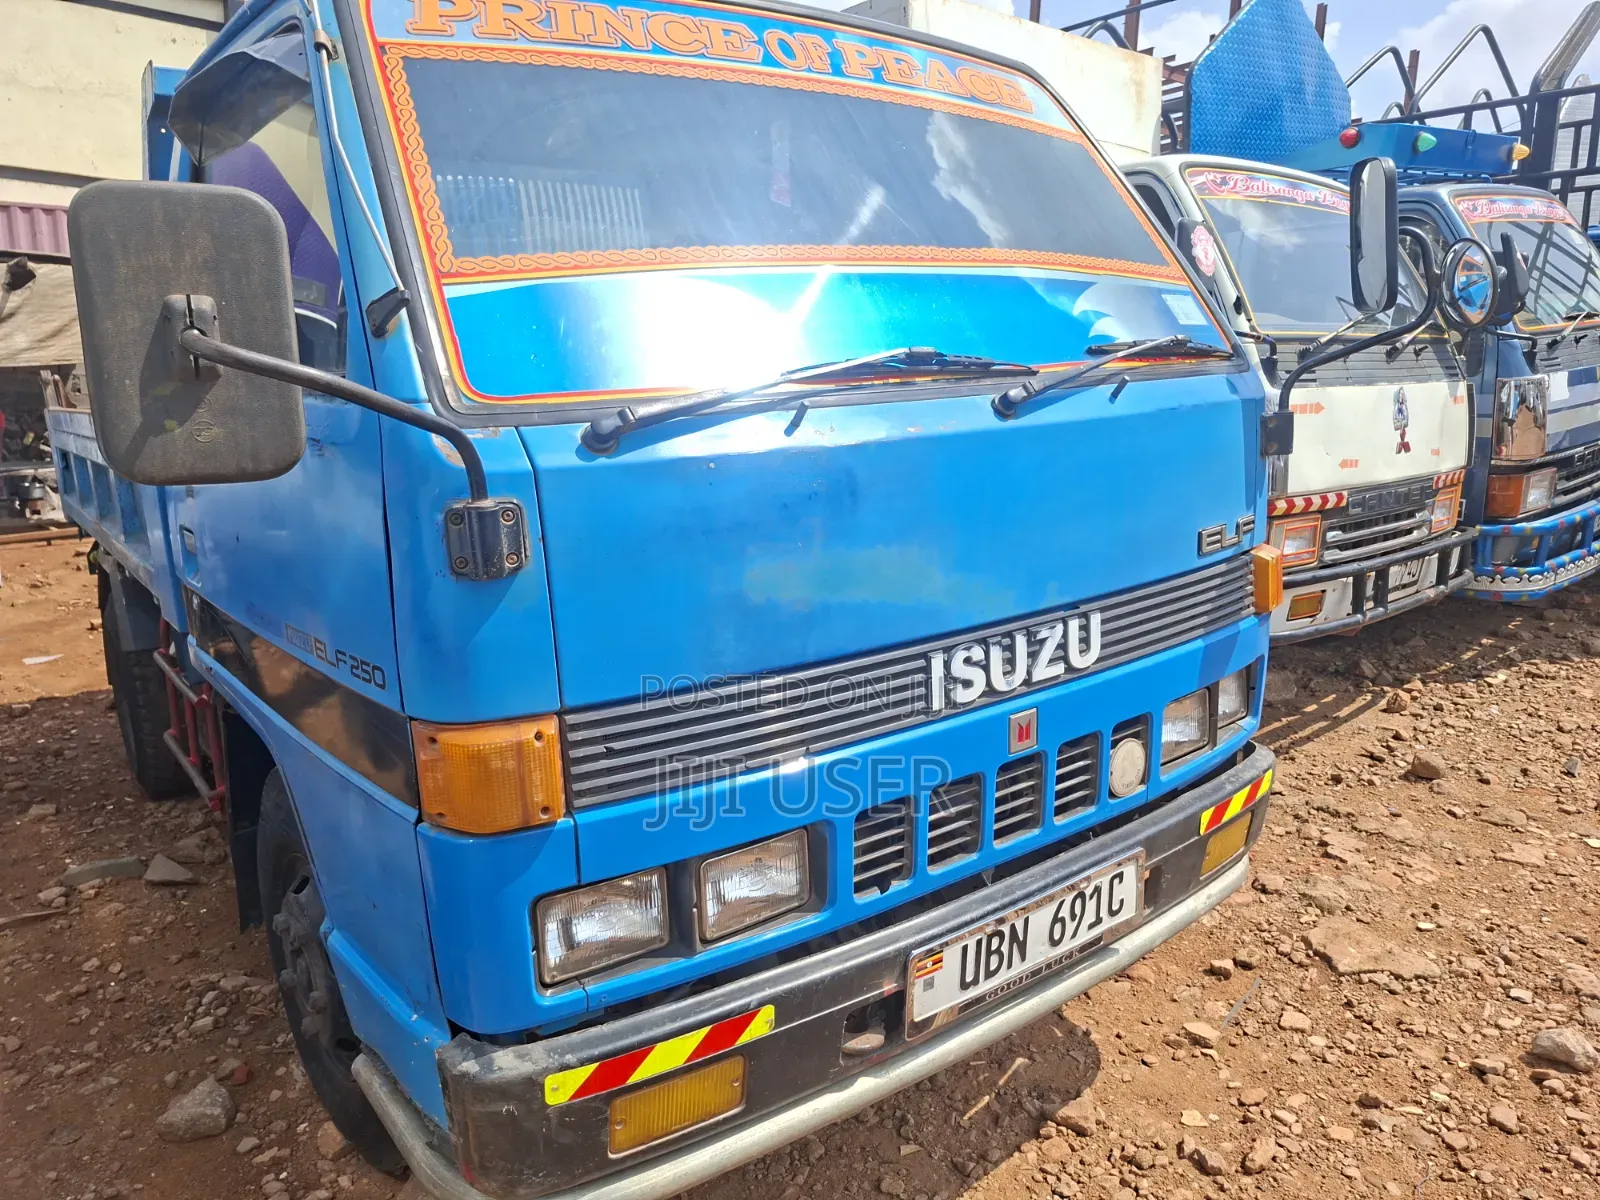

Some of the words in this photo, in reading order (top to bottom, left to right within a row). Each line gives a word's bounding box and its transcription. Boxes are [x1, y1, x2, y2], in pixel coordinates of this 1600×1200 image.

[405, 0, 763, 62] PRINCE
[764, 29, 832, 73] OF
[833, 39, 1034, 113] PEACE
[1198, 514, 1254, 555] ELF
[313, 636, 347, 669] ELF
[348, 654, 386, 690] 250
[928, 612, 1102, 711] ISUZU
[959, 915, 1029, 992] UBN
[1049, 871, 1125, 948] 691C
[985, 973, 1031, 1001] GOOD
[1041, 948, 1081, 974] LUCK
